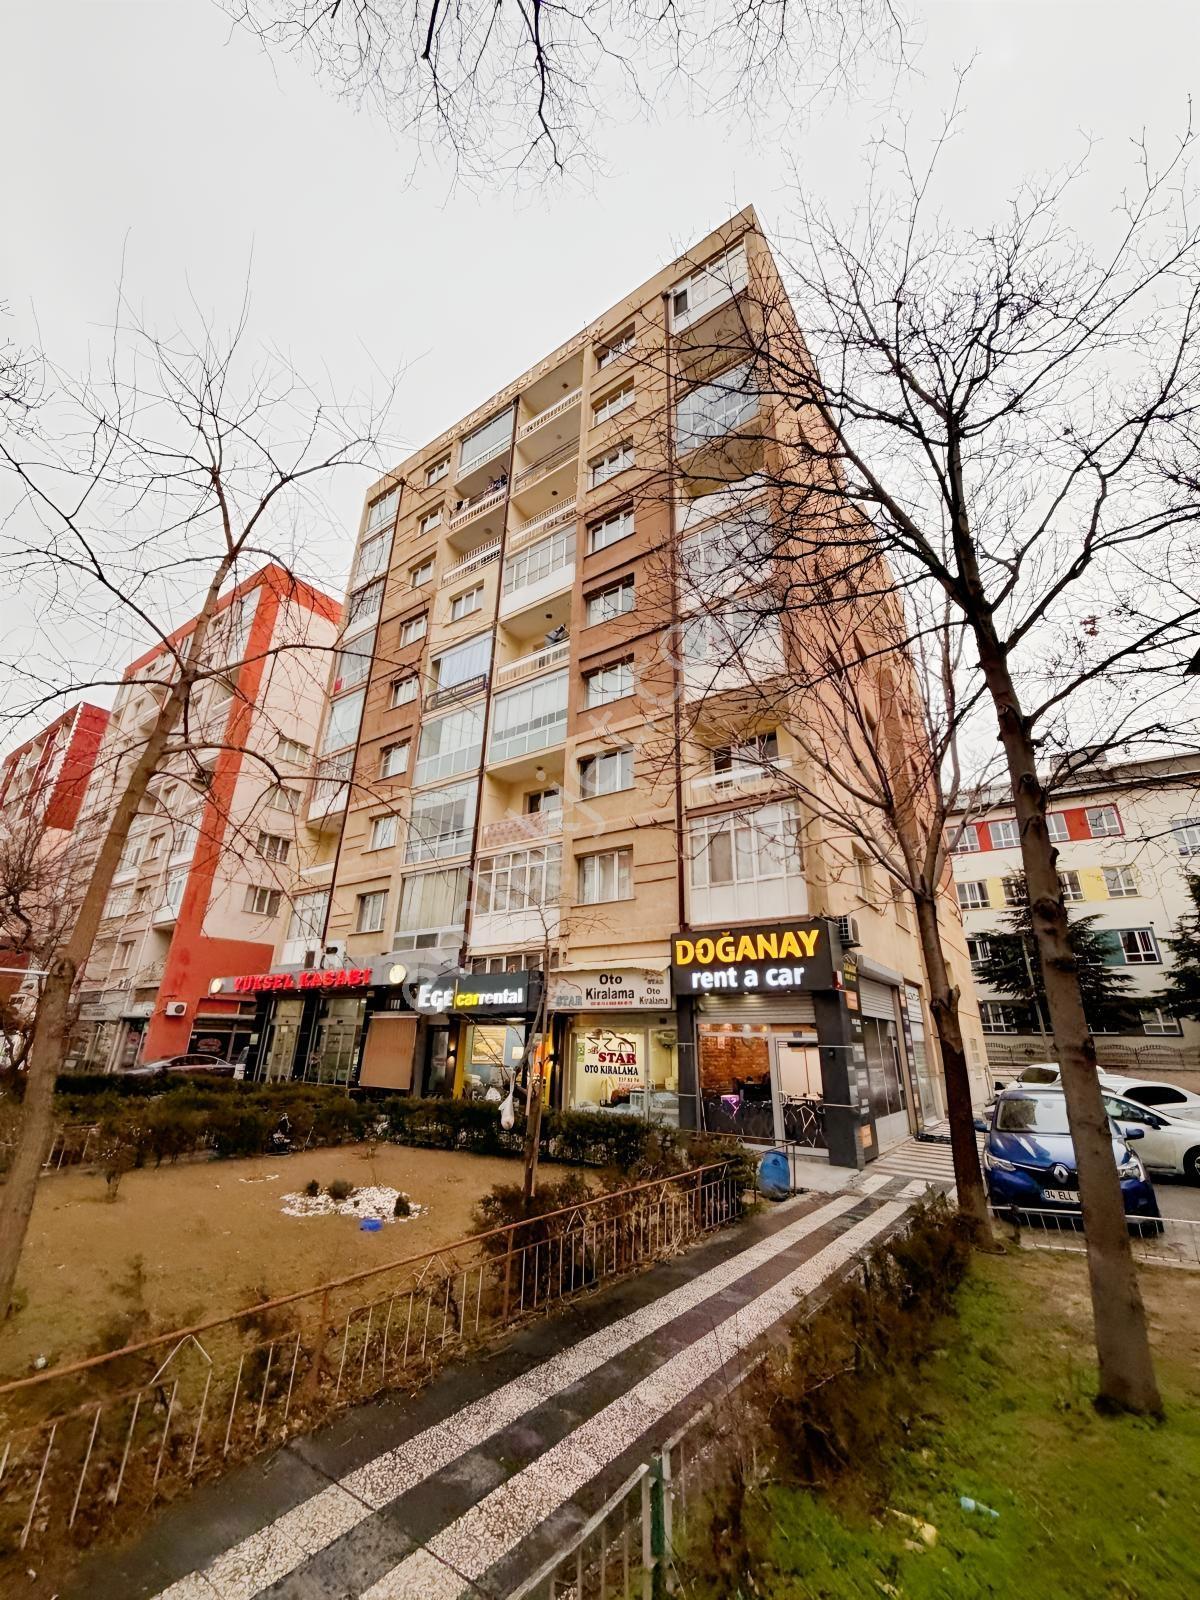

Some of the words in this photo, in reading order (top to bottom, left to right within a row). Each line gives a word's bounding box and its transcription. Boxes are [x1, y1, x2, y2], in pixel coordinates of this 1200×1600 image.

[675, 929, 820, 966] DOĞANAY
[599, 974, 623, 985] Oto
[691, 967, 738, 989] rent
[743, 969, 759, 987] a
[765, 967, 805, 987] car
[646, 987, 661, 995] Oto
[598, 1052, 636, 1064] STAR
[584, 1064, 599, 1074] OTO
